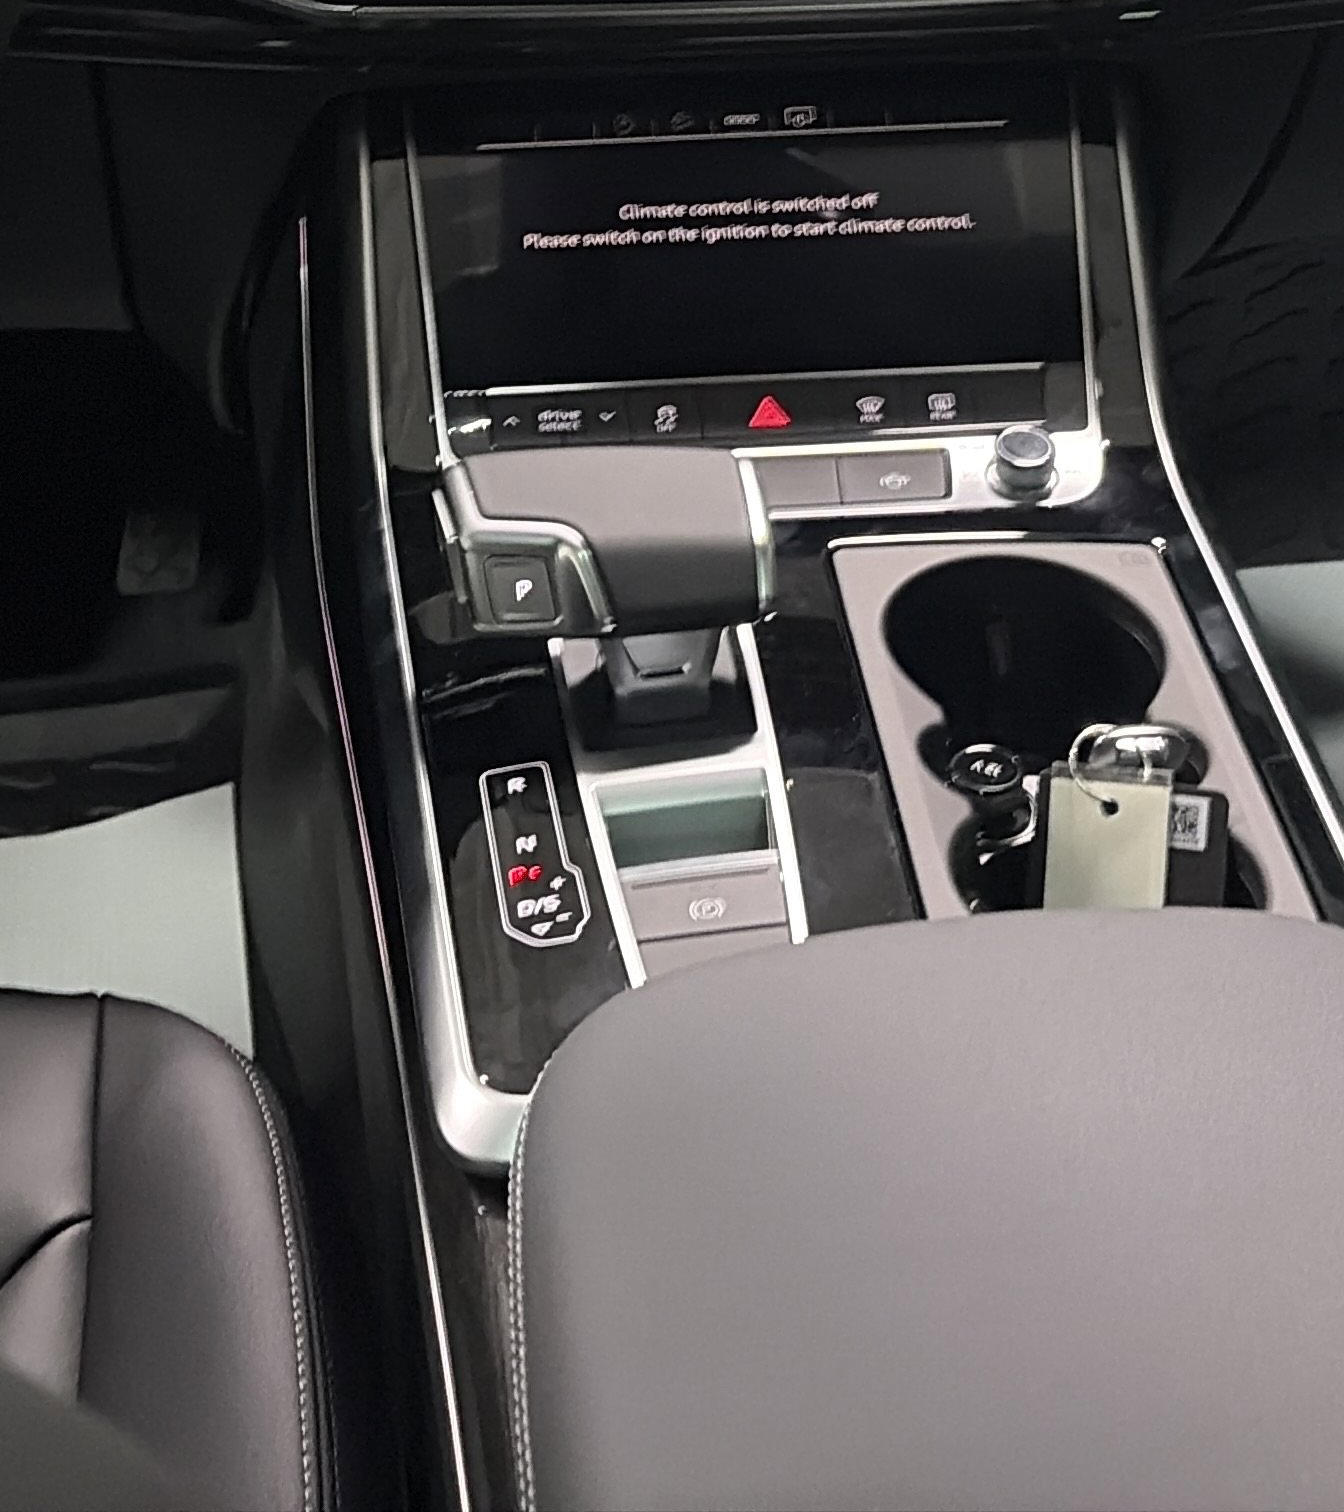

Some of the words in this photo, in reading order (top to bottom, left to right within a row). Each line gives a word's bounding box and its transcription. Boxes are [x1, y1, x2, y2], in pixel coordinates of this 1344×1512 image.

[619, 203, 688, 221] Climate
[688, 198, 752, 217] control
[754, 198, 770, 214] is
[771, 193, 850, 213] switched
[851, 192, 880, 209] off
[523, 232, 581, 249] Please
[582, 228, 641, 246] switch
[641, 229, 666, 244] on
[668, 226, 699, 243] the
[701, 223, 768, 245] ignition
[770, 223, 792, 238] to
[793, 219, 838, 236] start
[838, 216, 906, 235] climate
[906, 213, 976, 232] control.
[537, 409, 583, 422] drive
[515, 578, 532, 601] P
[507, 776, 528, 795] R
[515, 834, 537, 855] N
